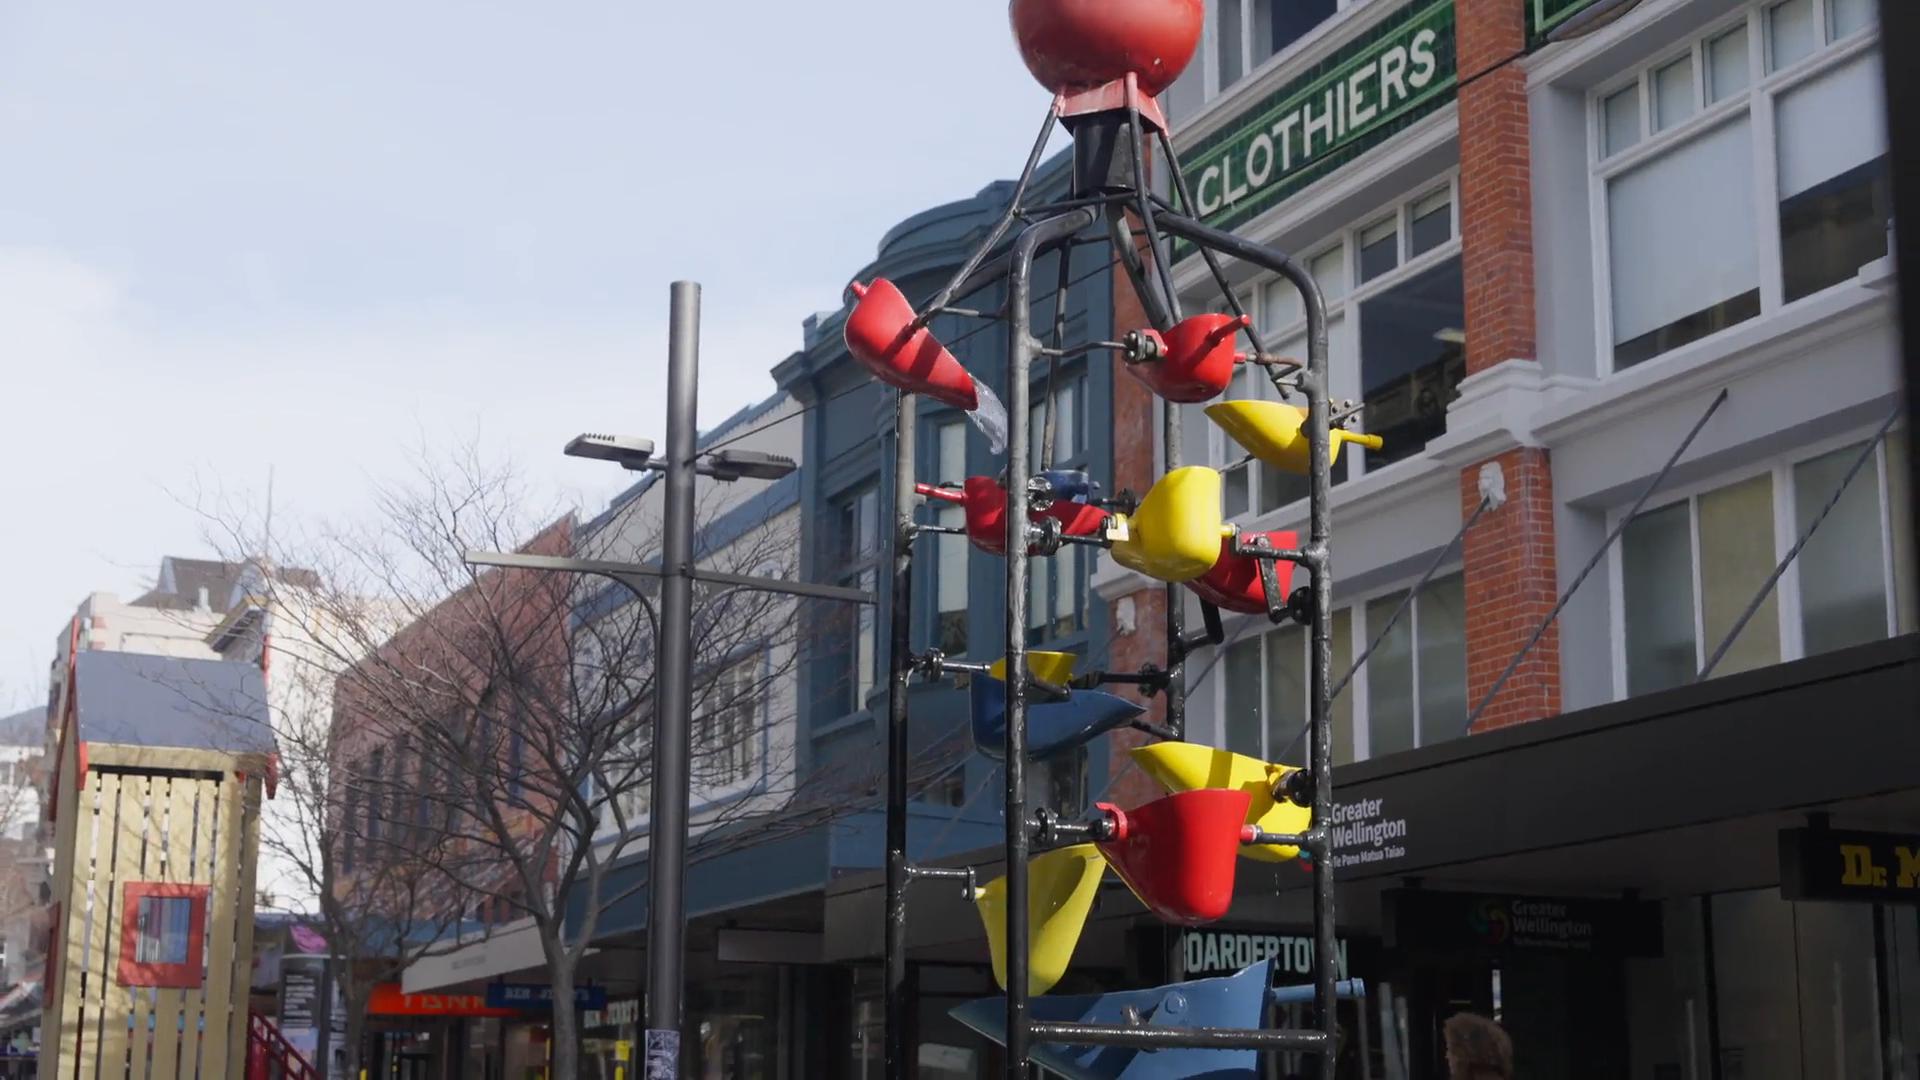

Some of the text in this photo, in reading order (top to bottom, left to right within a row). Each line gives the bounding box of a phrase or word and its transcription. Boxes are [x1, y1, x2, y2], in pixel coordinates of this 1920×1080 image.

[1197, 28, 1416, 217] CLOTHIERS
[1332, 798, 1383, 824] Greater
[1332, 818, 1406, 848] Wellington
[1512, 900, 1567, 917] Greater
[1512, 916, 1592, 939] Wellington
[1184, 932, 1348, 981] OARDERTON
